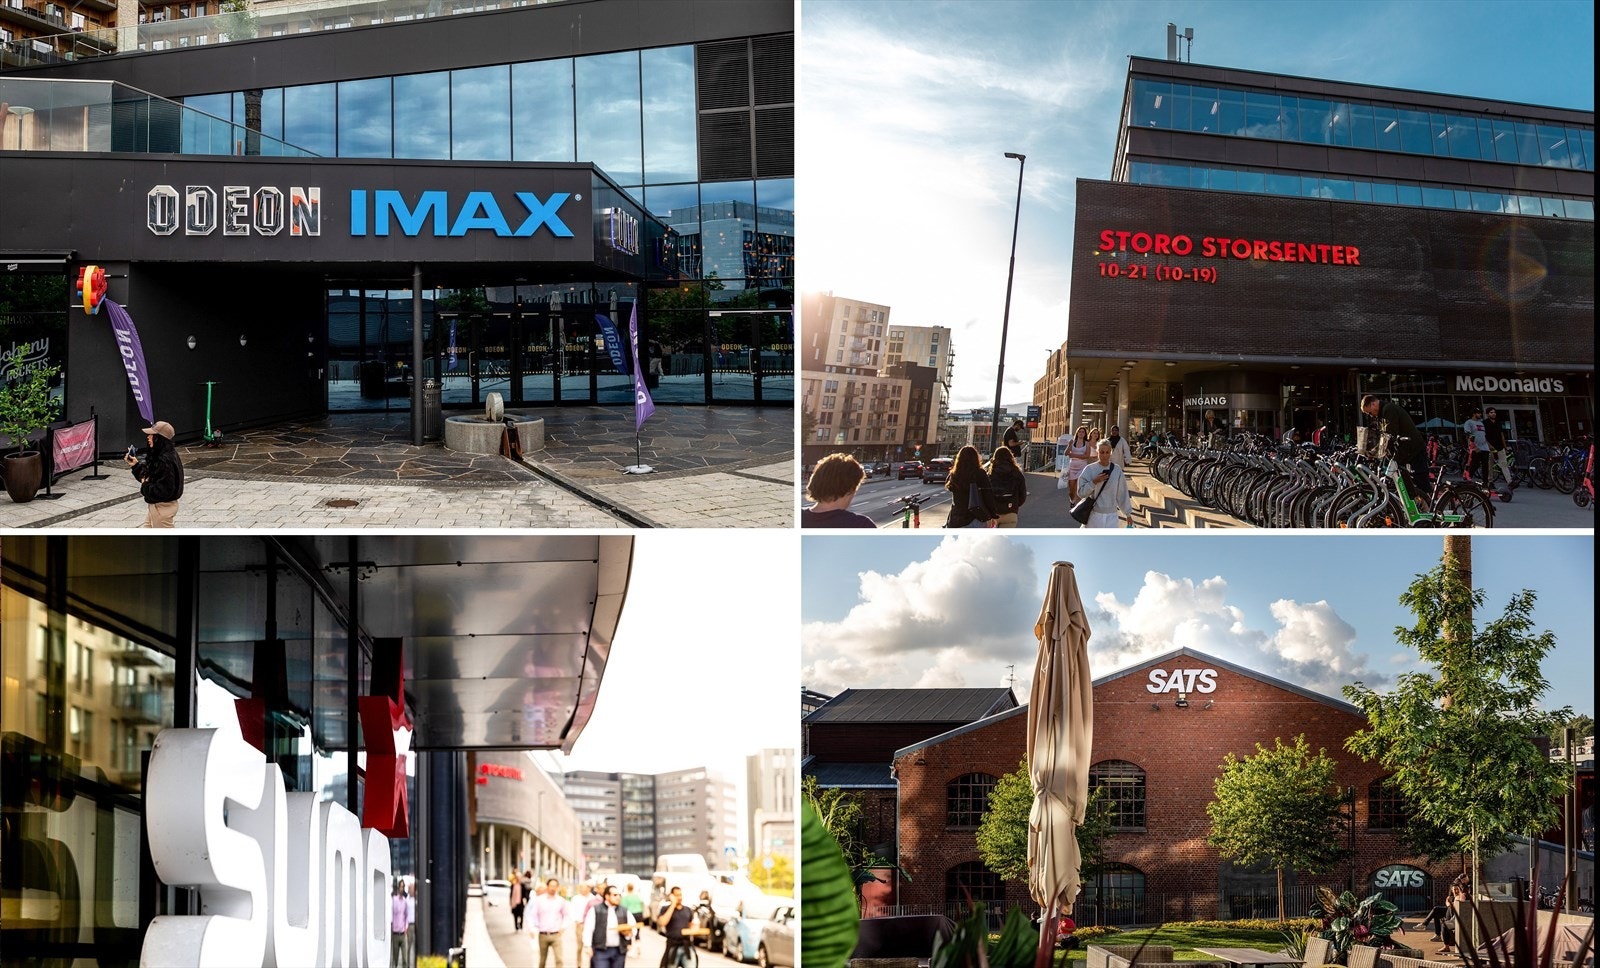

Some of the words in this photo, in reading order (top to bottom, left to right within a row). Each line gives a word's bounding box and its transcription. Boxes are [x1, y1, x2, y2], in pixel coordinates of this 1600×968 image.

[147, 185, 321, 235] ODEON
[1099, 229, 1193, 257] STORO
[1201, 236, 1361, 267] STORSENTER
[1098, 262, 1147, 279] 10-21
[1155, 263, 1217, 284] (10-19)
[484, 345, 505, 353] ODEON
[1455, 374, 1565, 394] McDonald's
[1184, 396, 1227, 406] INNGANG
[1146, 668, 1218, 694] SATS
[1374, 868, 1425, 888] SATS
